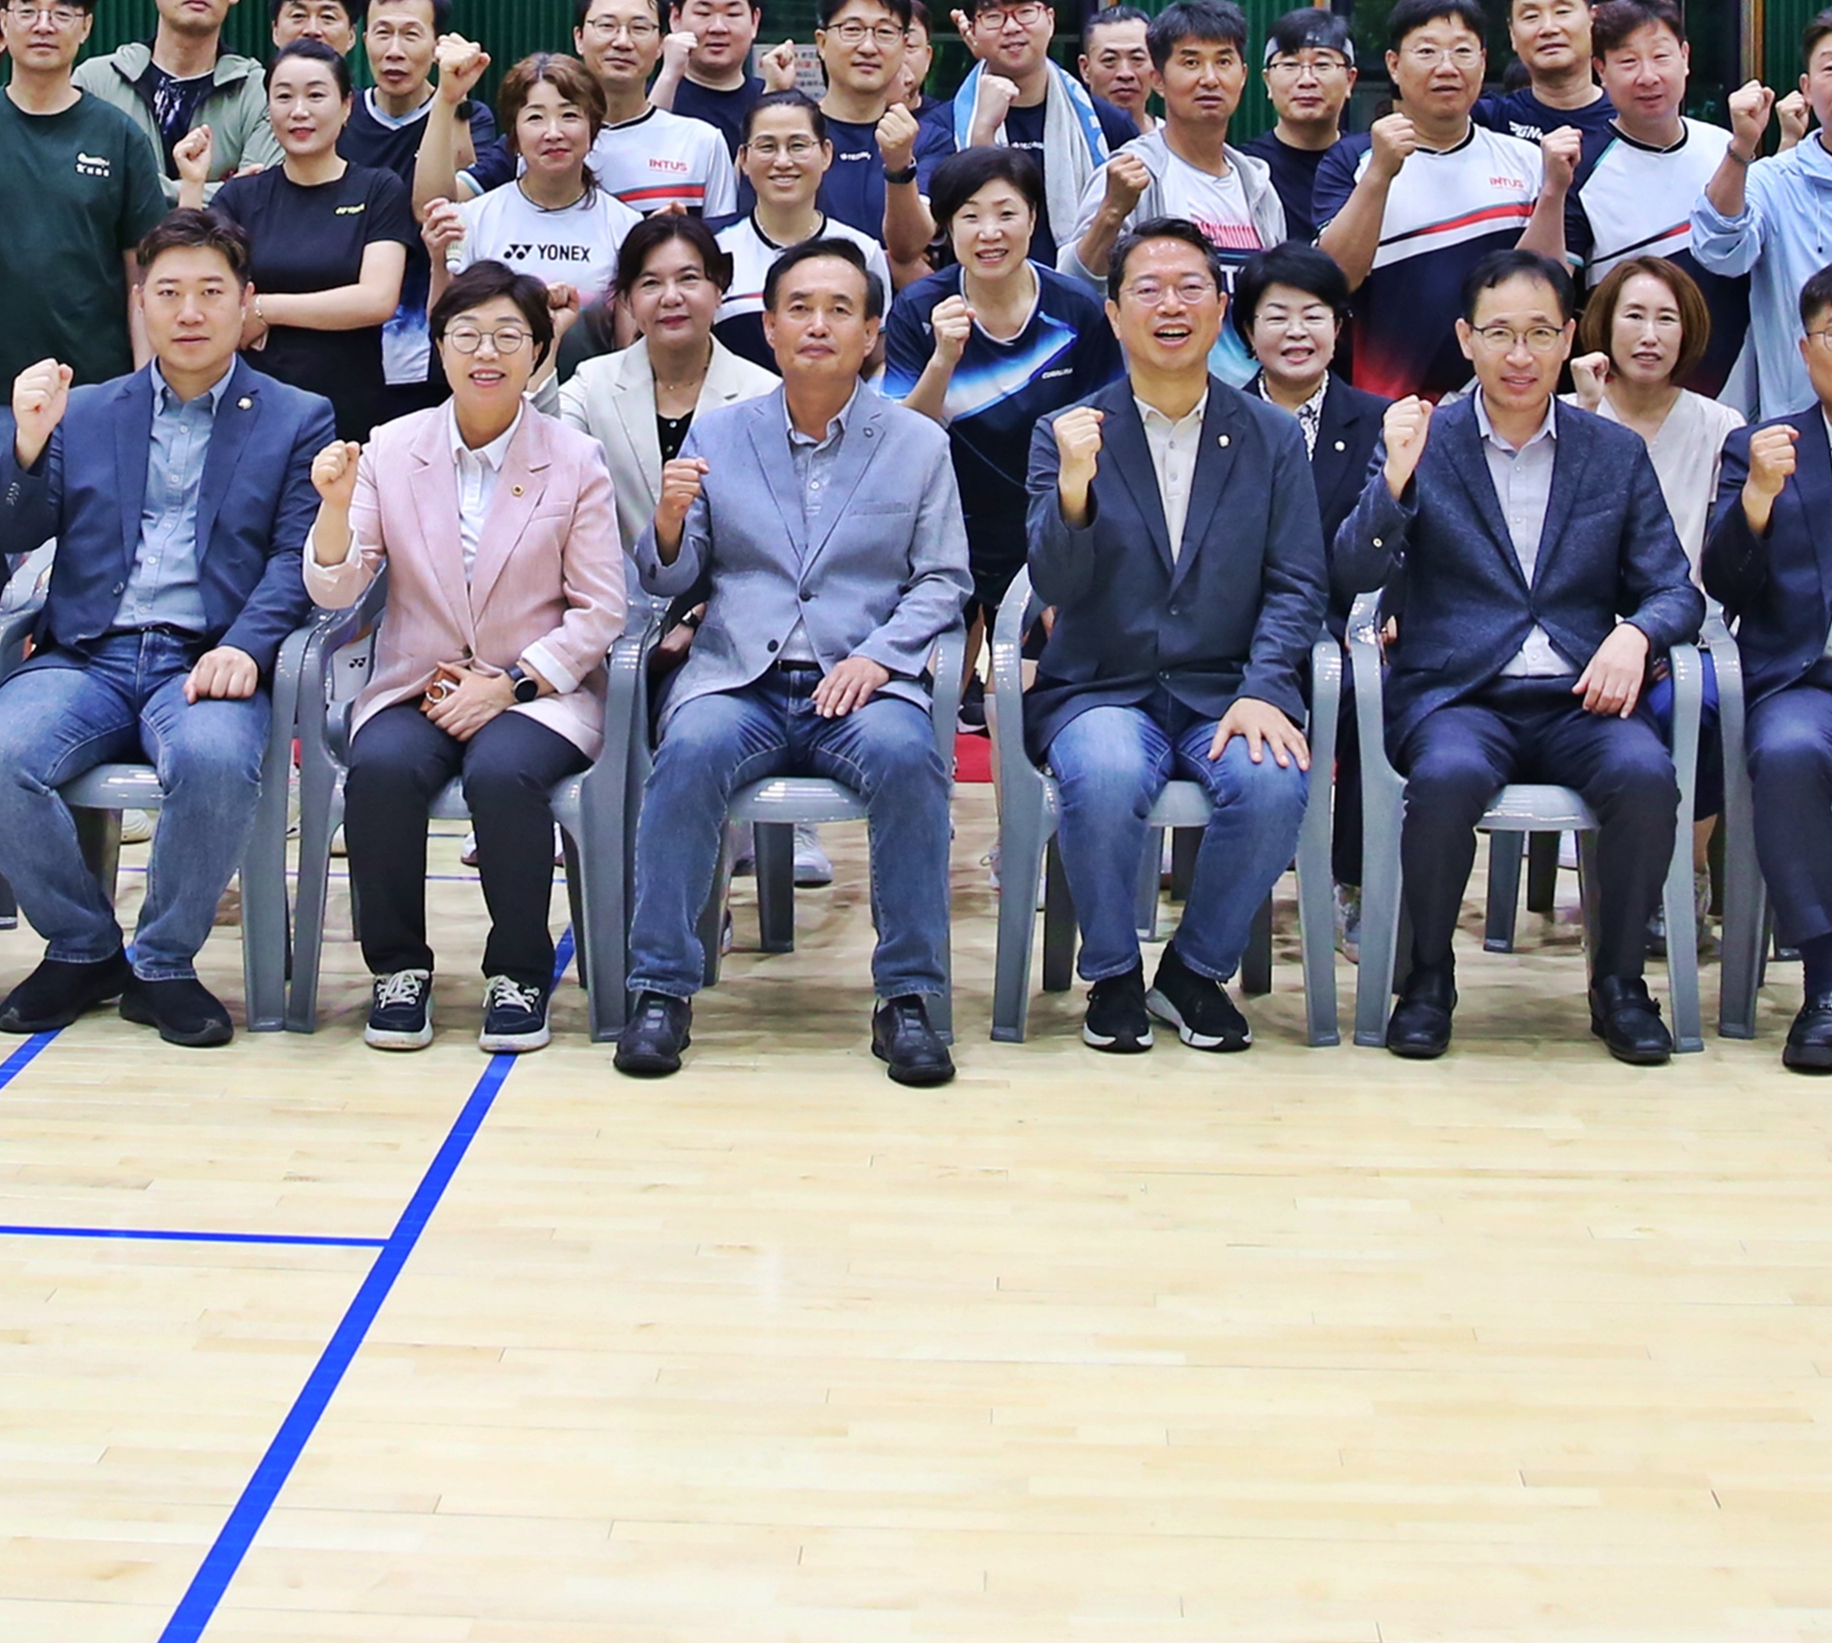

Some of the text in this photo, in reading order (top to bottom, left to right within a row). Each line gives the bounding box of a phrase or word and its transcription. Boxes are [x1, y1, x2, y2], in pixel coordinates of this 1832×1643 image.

[649, 158, 688, 172] INTUS
[1489, 176, 1524, 189] INTUS
[537, 243, 591, 263] YONEX
